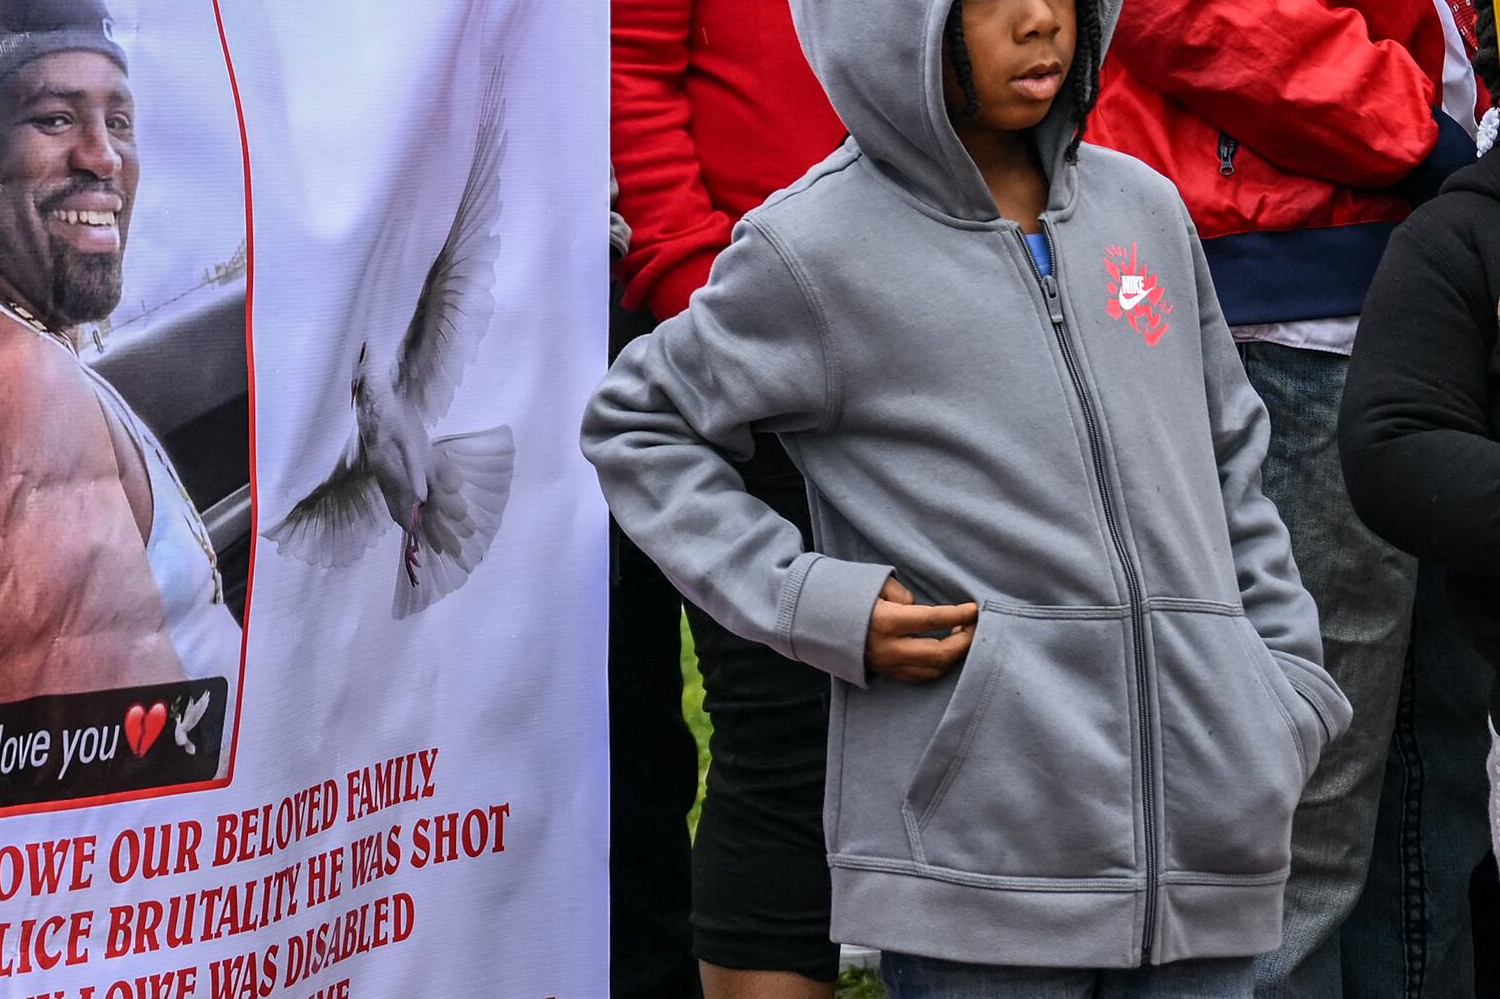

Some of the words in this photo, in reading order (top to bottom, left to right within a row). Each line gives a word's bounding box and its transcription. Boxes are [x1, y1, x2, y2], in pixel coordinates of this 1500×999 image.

[1121, 275, 1145, 295] NIKE
[57, 724, 121, 780] you
[109, 820, 203, 884] OUR
[211, 783, 339, 867] BELOVED
[347, 748, 439, 822] FAMILY
[104, 861, 301, 960] BRUTALITY
[307, 847, 345, 908] HE
[351, 824, 402, 889] WAS
[410, 804, 511, 869] SHOT
[209, 944, 280, 999] WAS
[284, 891, 416, 989] DISABLED
